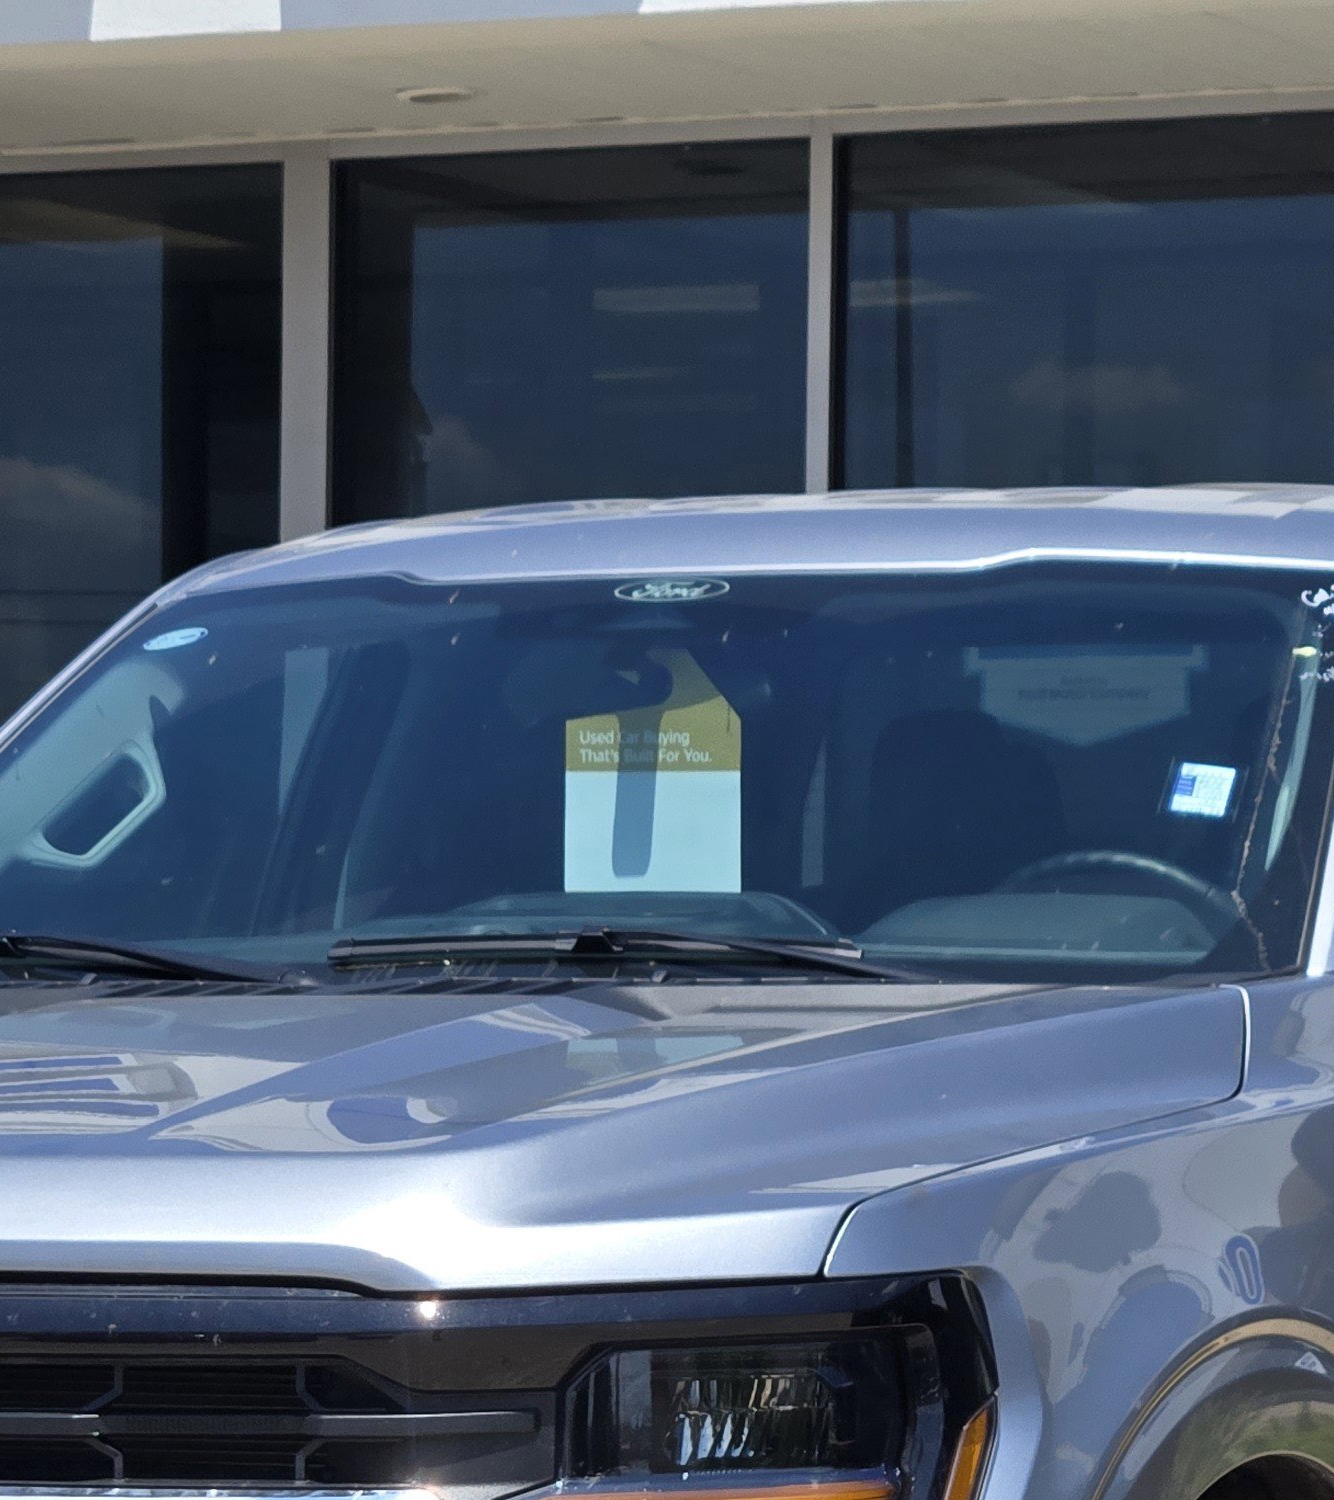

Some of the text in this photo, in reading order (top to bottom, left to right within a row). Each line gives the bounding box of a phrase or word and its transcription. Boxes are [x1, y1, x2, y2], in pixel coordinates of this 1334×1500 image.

[579, 730, 615, 744] Used
[579, 748, 620, 763] That's
[658, 748, 680, 762] For
[683, 748, 713, 763] You.
